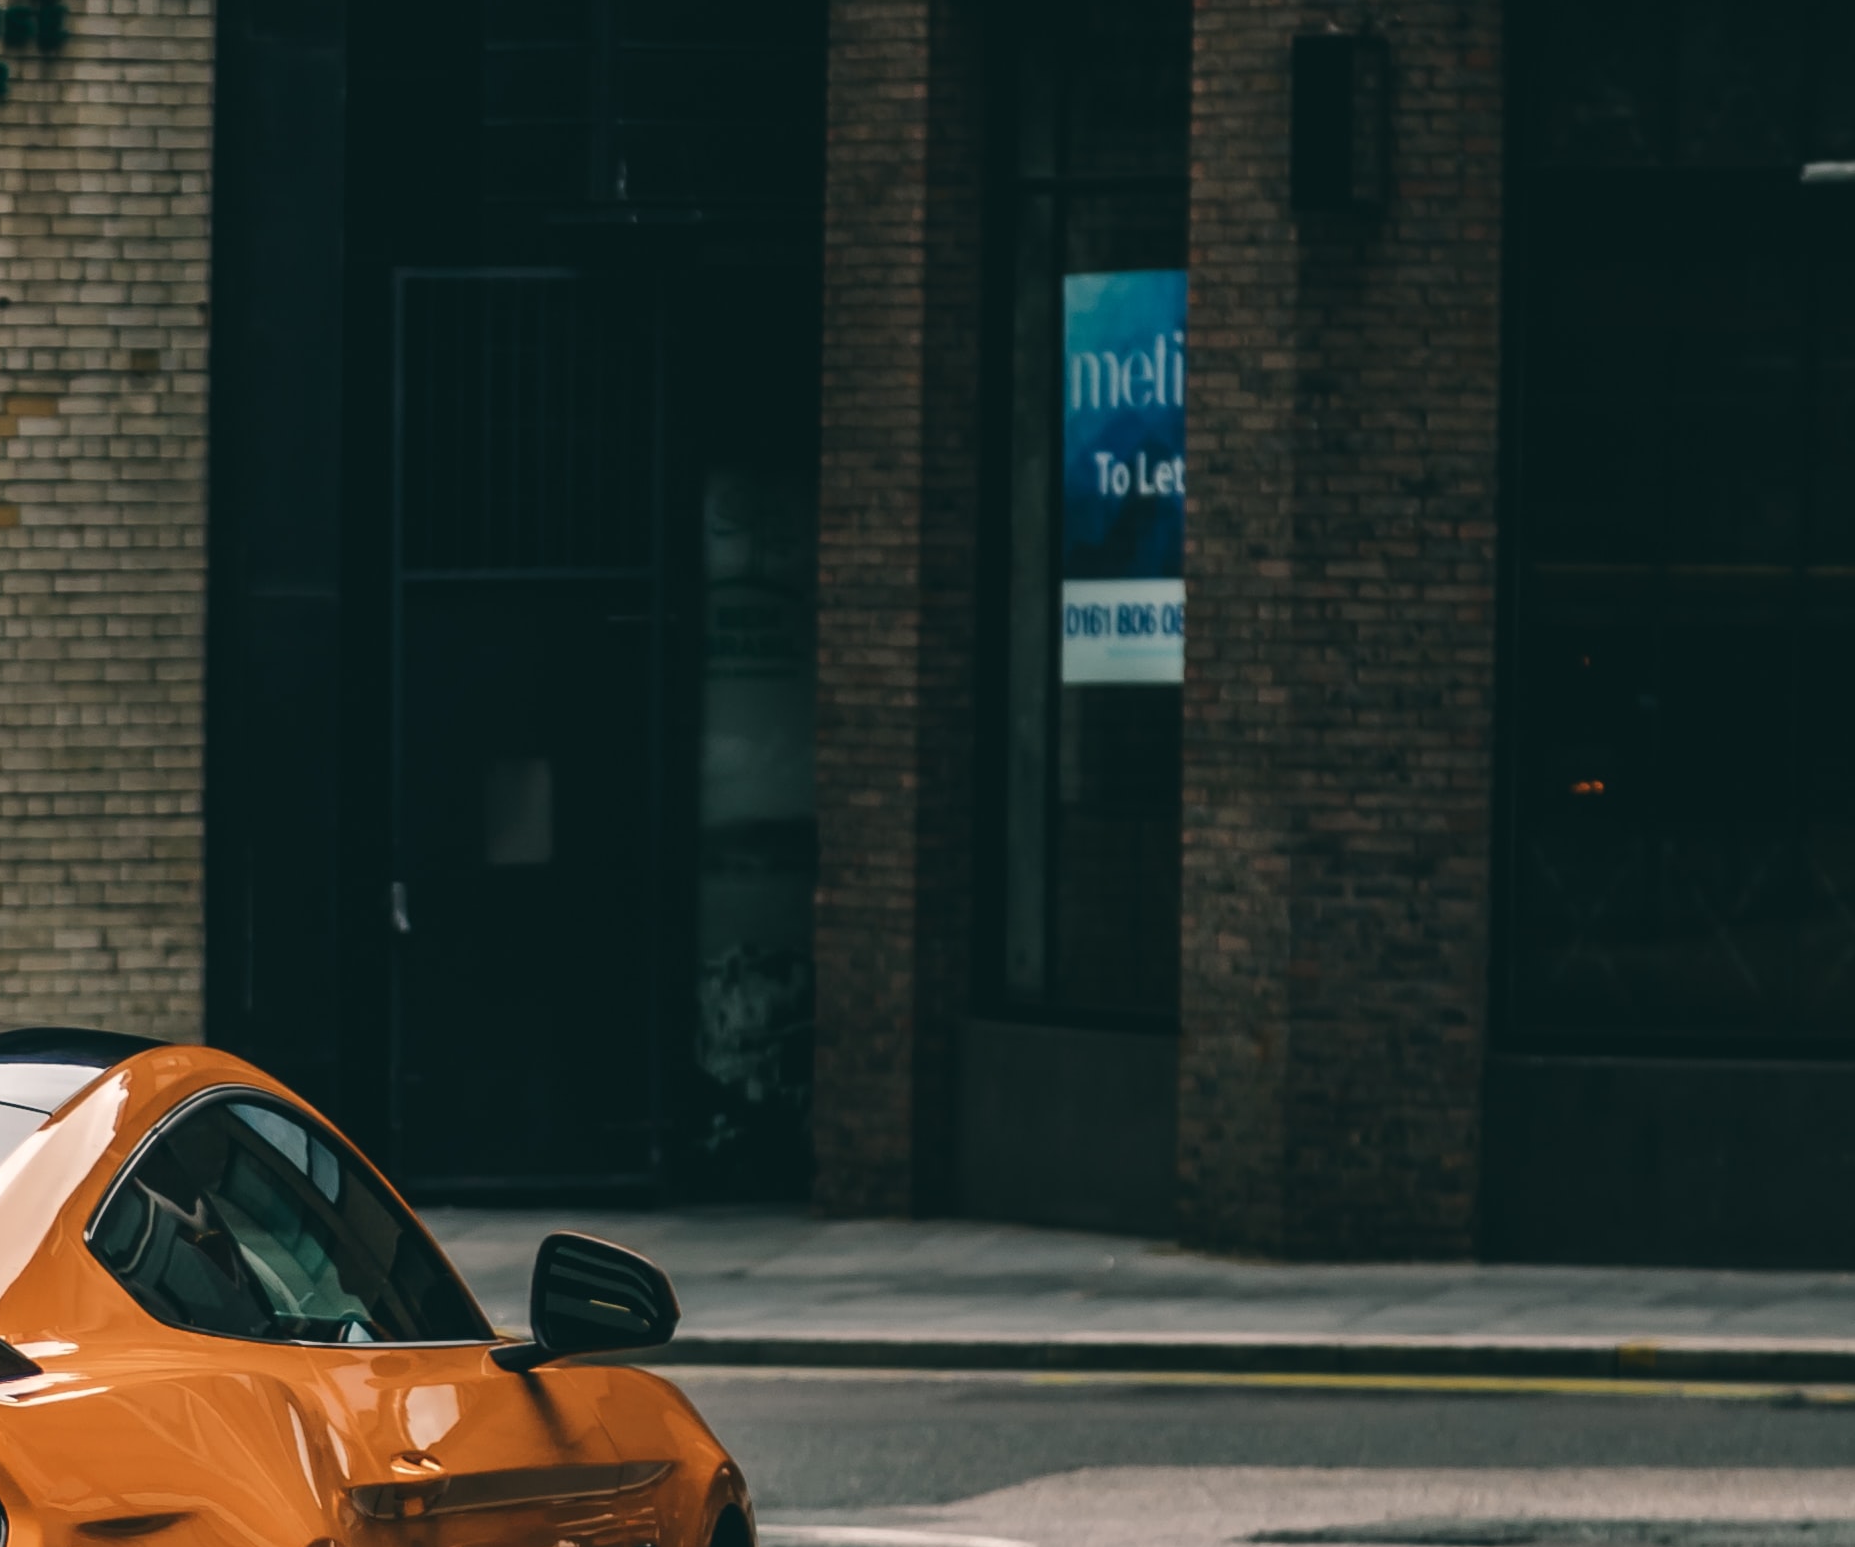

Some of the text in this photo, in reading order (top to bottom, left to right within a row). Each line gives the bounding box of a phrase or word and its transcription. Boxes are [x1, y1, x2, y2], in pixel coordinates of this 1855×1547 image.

[1094, 452, 1185, 496] To Let
[1065, 603, 1111, 636] 0161
